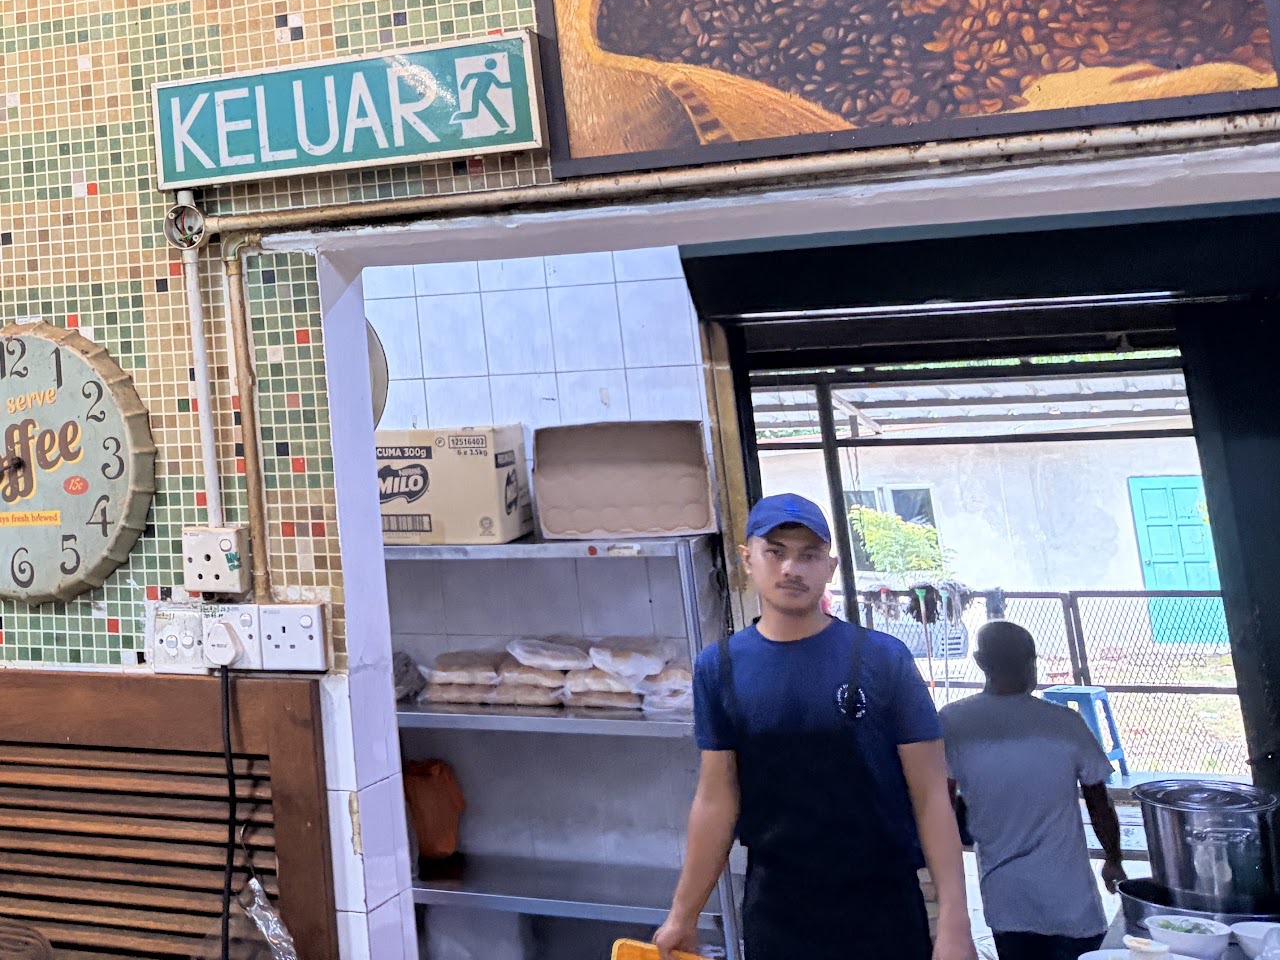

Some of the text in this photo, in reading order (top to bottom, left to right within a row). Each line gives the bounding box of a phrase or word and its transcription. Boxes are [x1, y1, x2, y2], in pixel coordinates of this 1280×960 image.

[170, 67, 440, 172] KELUAR
[51, 347, 63, 390] 1
[7, 388, 57, 414] serve
[82, 380, 105, 423] 2
[101, 437, 125, 480] 3
[376, 448, 427, 458] CUMA 300g
[379, 474, 424, 494] MILO
[11, 514, 30, 523] fresh
[31, 513, 58, 522] brewed
[86, 495, 114, 538] 4
[11, 547, 35, 588] 6
[60, 534, 81, 575] 5
